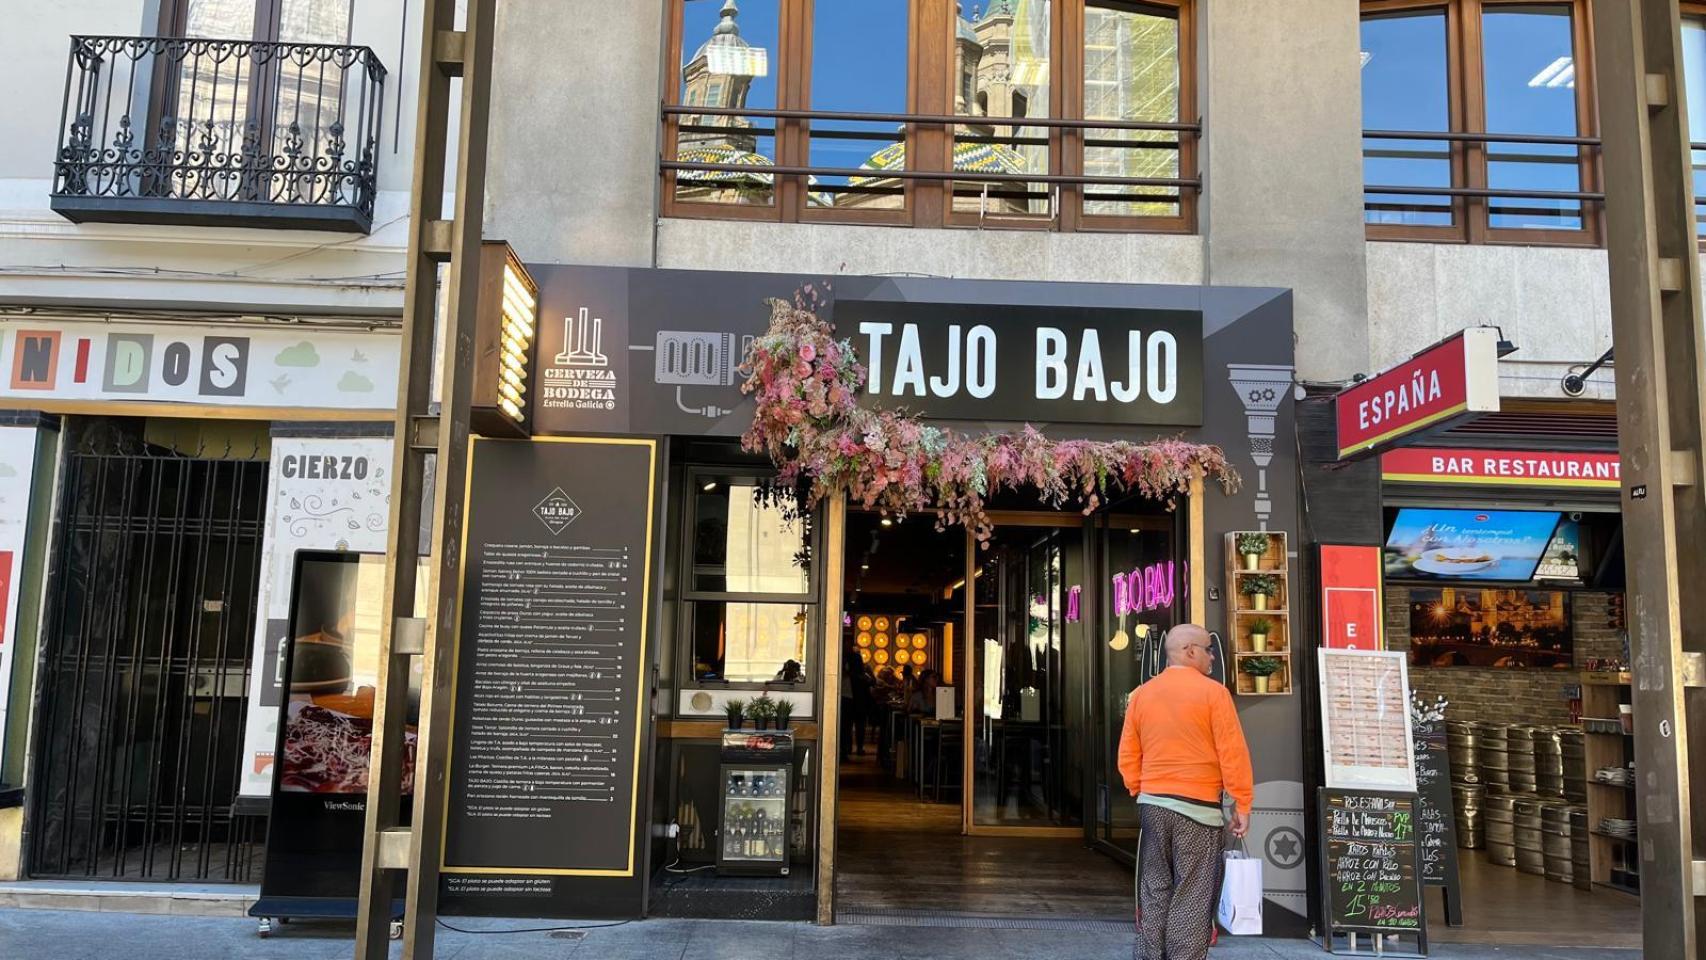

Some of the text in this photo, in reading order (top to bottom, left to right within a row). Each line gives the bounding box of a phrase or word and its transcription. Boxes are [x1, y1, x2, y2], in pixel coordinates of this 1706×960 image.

[859, 322, 1177, 404] TAJO BAJO
[544, 368, 616, 380] CERVEZA
[543, 387, 615, 400] BODEGA
[1359, 368, 1441, 430] ESPAÑA
[543, 399, 604, 409] Estrella Galicia
[281, 454, 368, 480] CIERZO
[1432, 457, 1474, 473] BAR
[540, 507, 574, 516] TAJO BAJO
[324, 801, 365, 811] ViewSonic
[1357, 881, 1366, 892] 2
